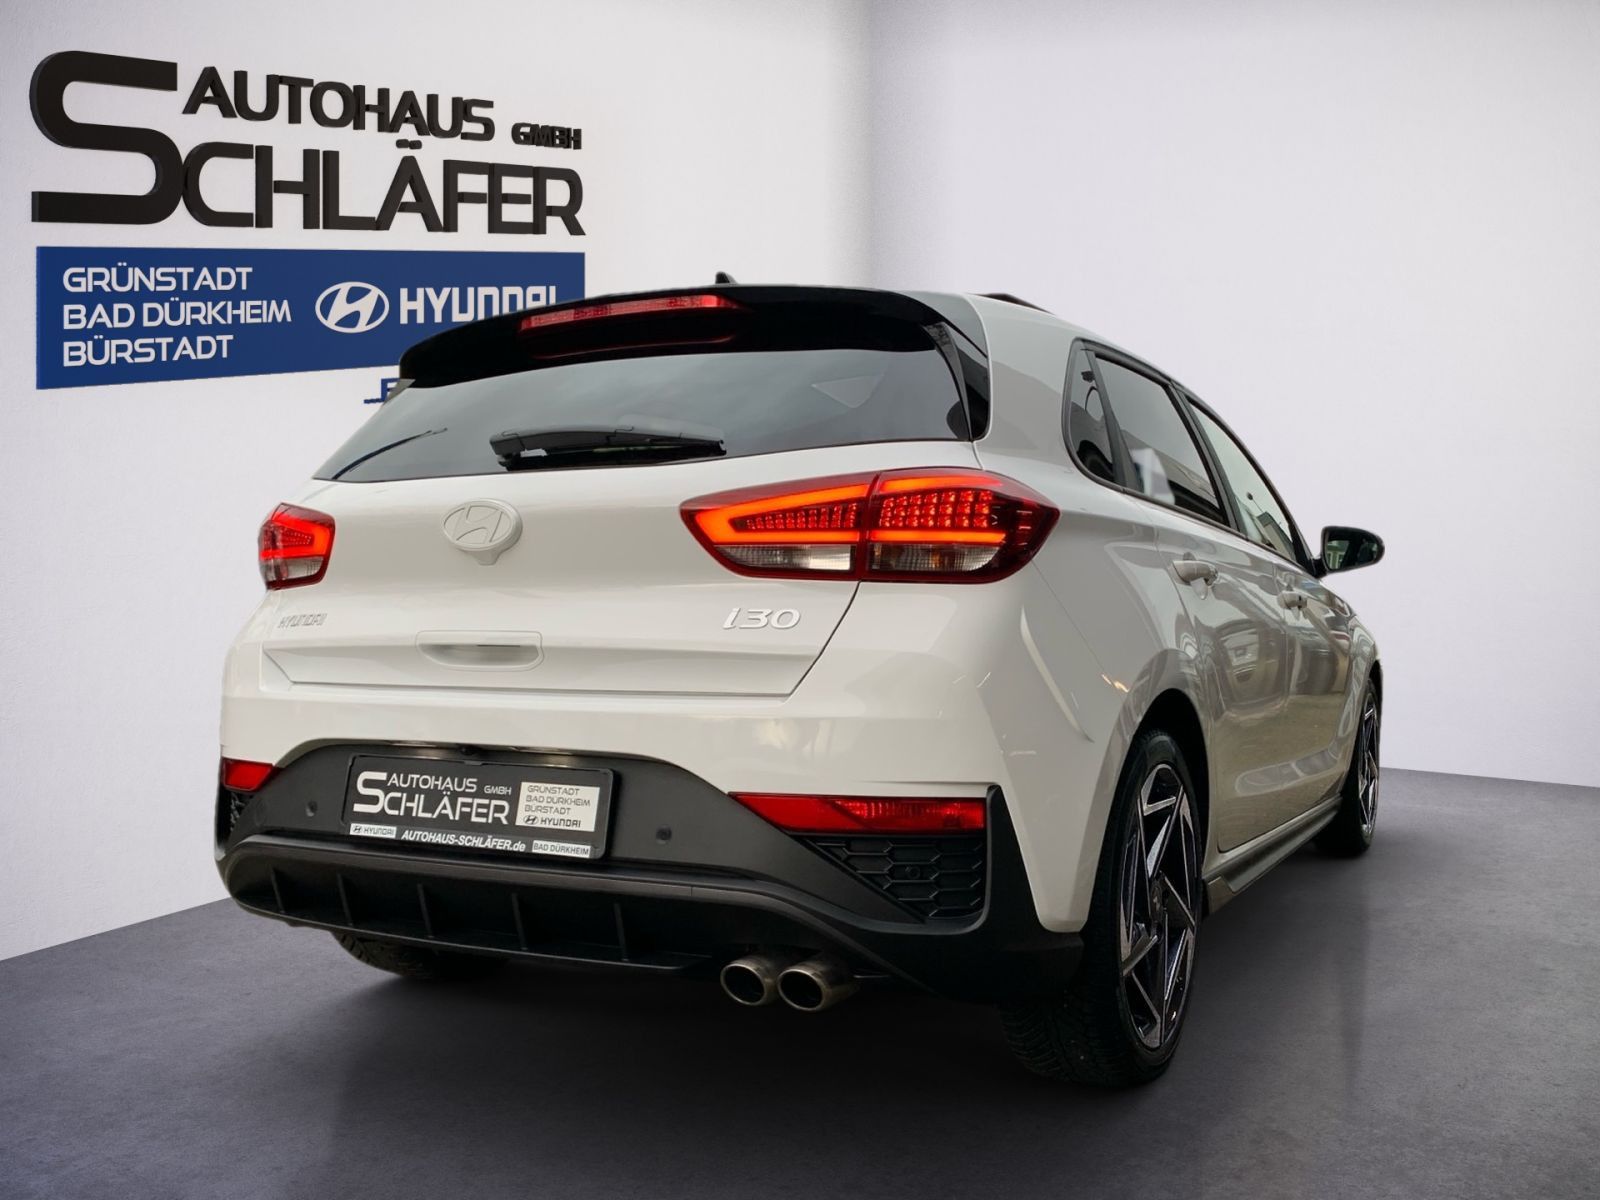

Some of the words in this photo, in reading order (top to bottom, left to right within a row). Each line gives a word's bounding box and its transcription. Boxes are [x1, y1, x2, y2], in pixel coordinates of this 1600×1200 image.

[183, 66, 495, 141] AUTOHAUS
[511, 122, 582, 150] GMBH
[29, 50, 586, 236] SCHLÄFER
[62, 262, 253, 293] GRÜNSTADT
[63, 303, 135, 330] BAD
[142, 297, 292, 327] DÜRKHEIM
[63, 334, 234, 367] BÜRSTADT
[722, 607, 801, 630] i30
[353, 771, 510, 825] SCHLÄFER
[387, 773, 477, 793] AUTOHAUS
[484, 785, 512, 796] GMBH
[525, 794, 545, 804] BAD
[541, 816, 581, 828] HYUNDAI
[533, 842, 549, 852] BAD
